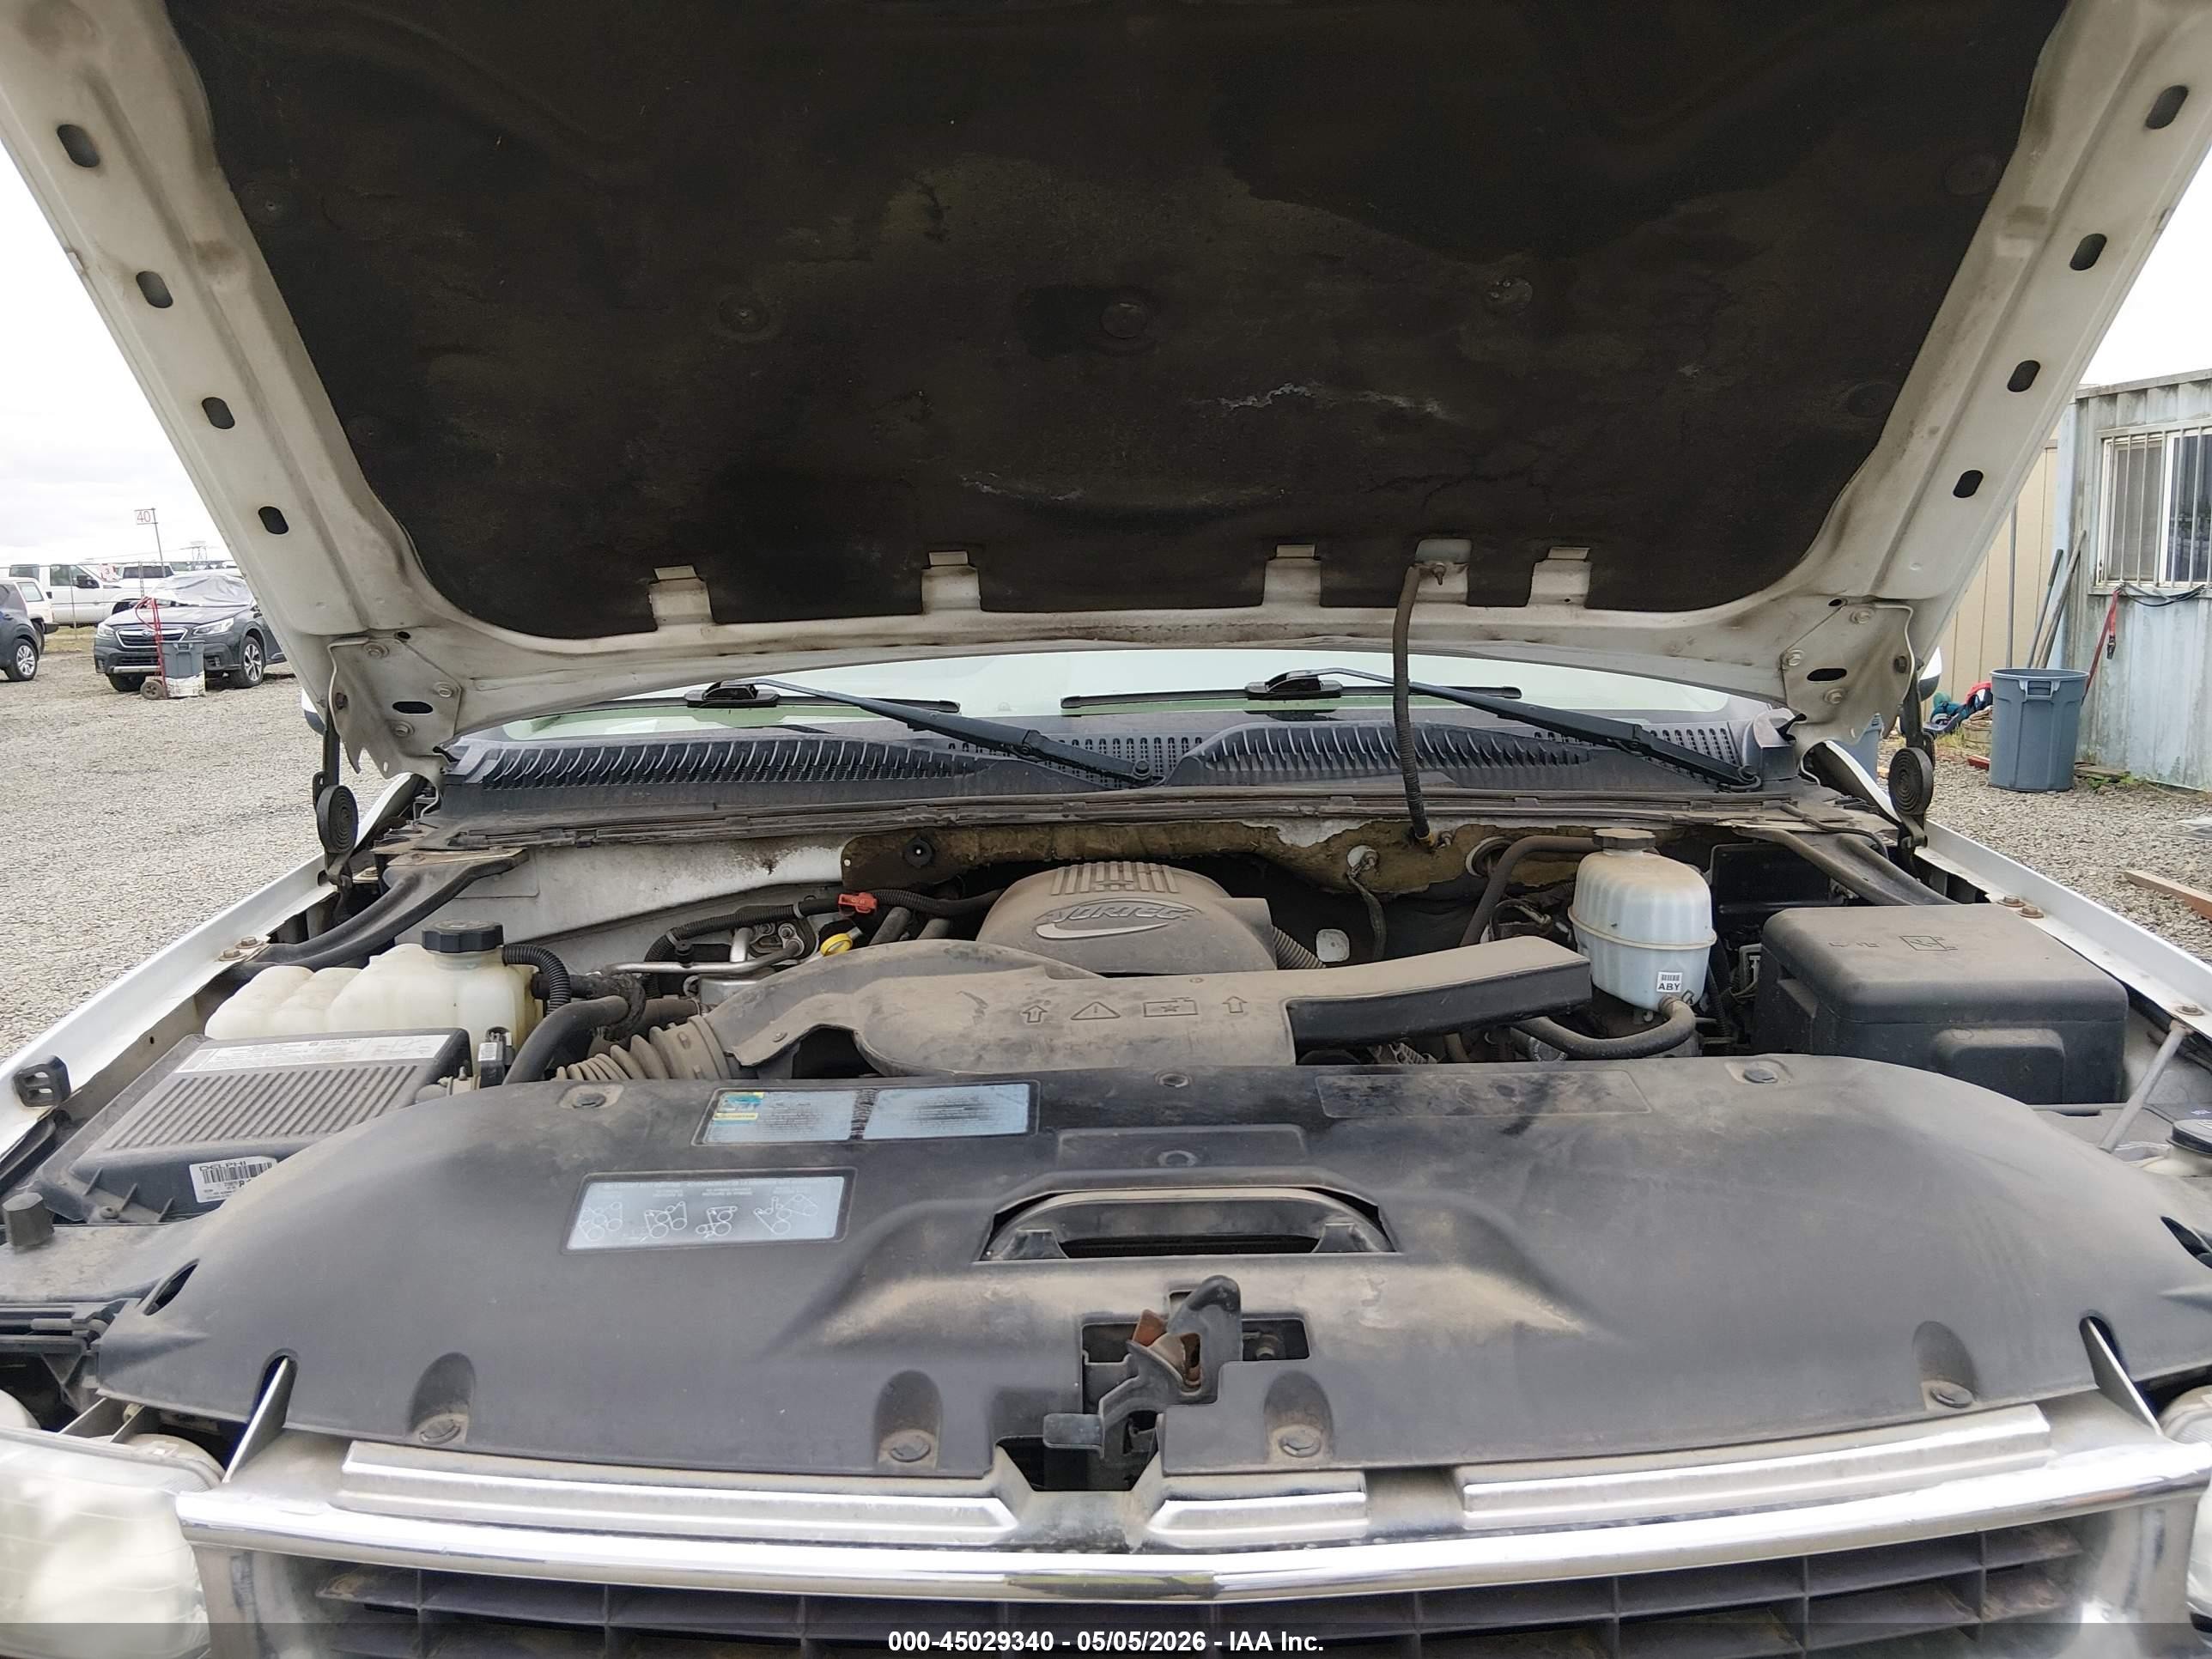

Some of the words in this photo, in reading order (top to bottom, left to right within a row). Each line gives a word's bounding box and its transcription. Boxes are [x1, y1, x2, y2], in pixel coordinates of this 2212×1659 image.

[137, 510, 151, 523] 40
[1047, 905, 1191, 923] VORTEC
[1657, 982, 1680, 991] ABY
[198, 1160, 246, 1172] DELPHI
